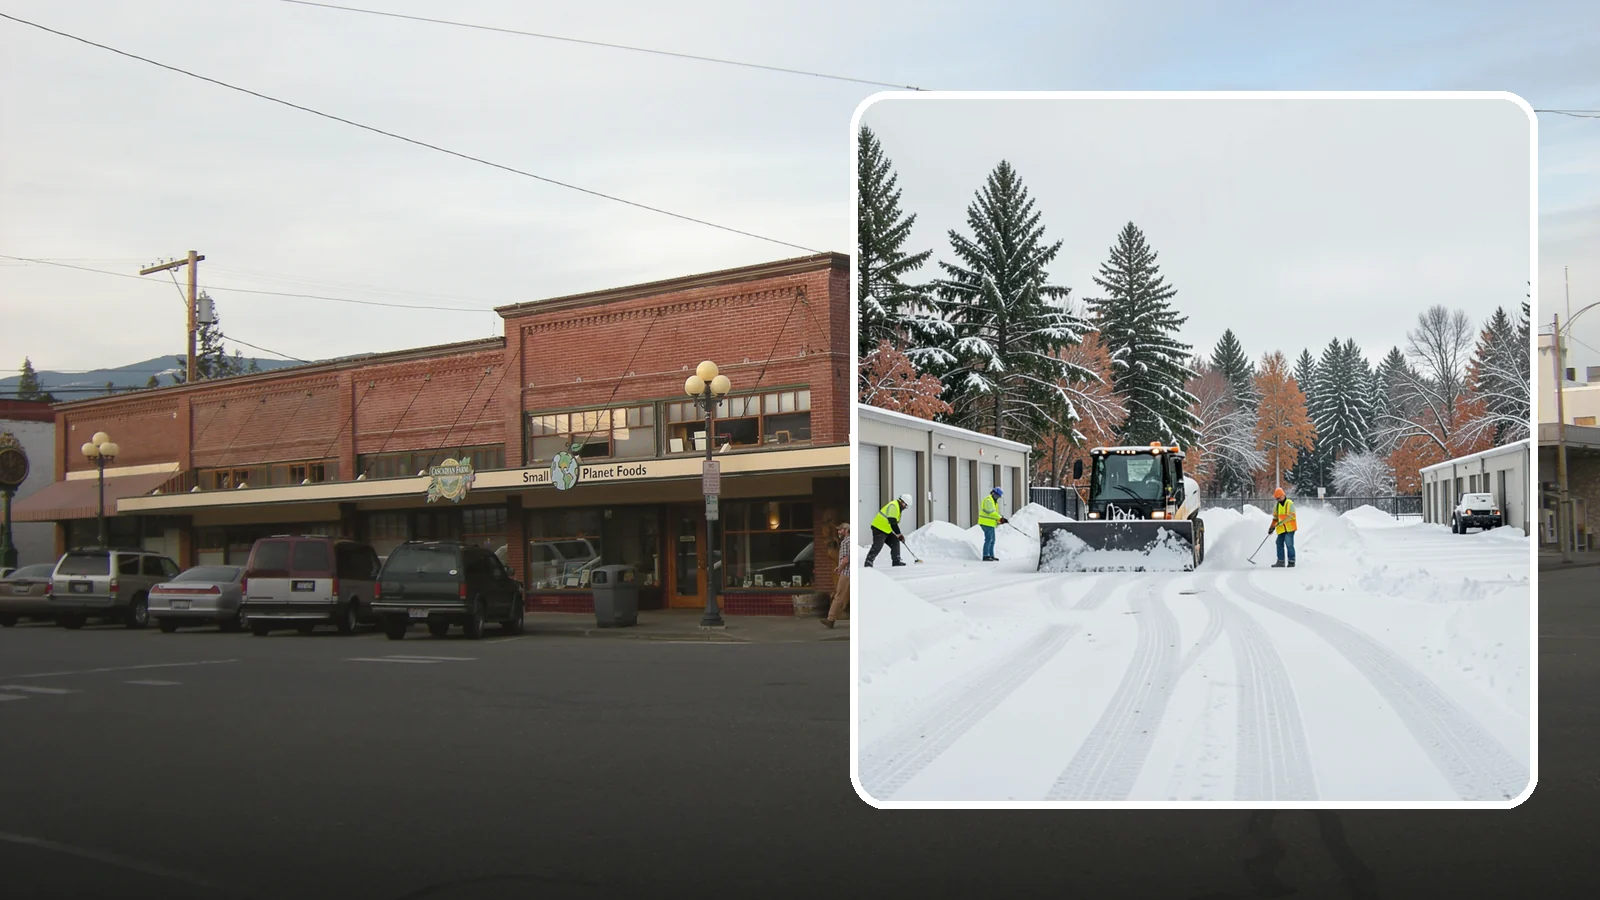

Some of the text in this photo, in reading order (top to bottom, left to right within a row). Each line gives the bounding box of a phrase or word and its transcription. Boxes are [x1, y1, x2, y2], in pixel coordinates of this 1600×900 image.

[523, 464, 647, 483] Small Planet Foods
